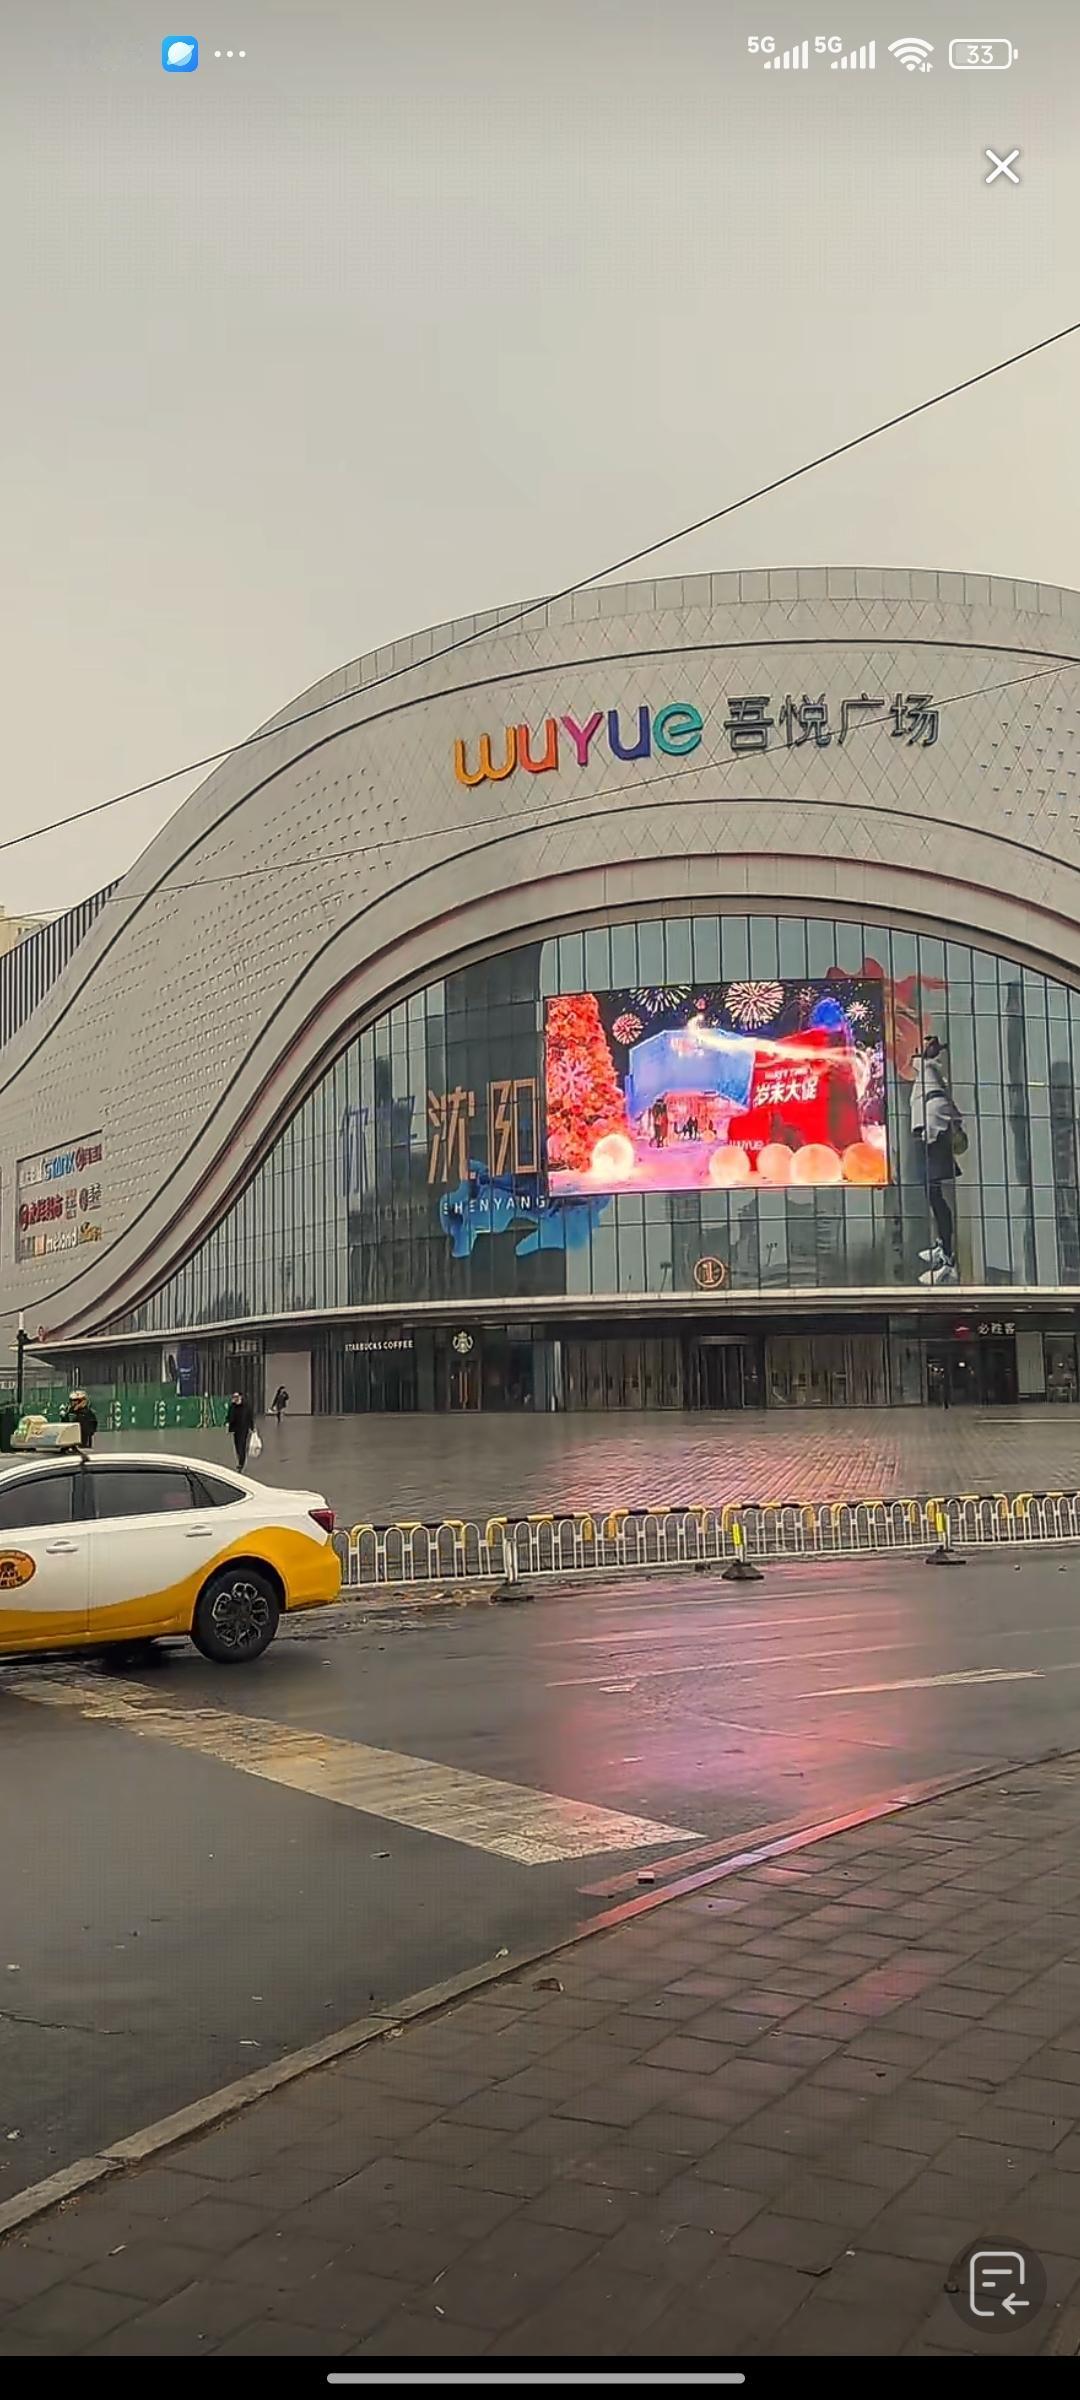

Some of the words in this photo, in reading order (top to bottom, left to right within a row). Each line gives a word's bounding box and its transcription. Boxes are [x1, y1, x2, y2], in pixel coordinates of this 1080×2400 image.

[722, 692, 941, 752] 吾悦广场
[753, 1076, 819, 1107] 岁末大促
[443, 1196, 548, 1216] SHENYANG
[977, 1321, 1016, 1336] 必胜客
[382, 1339, 414, 1350] COFFEE
